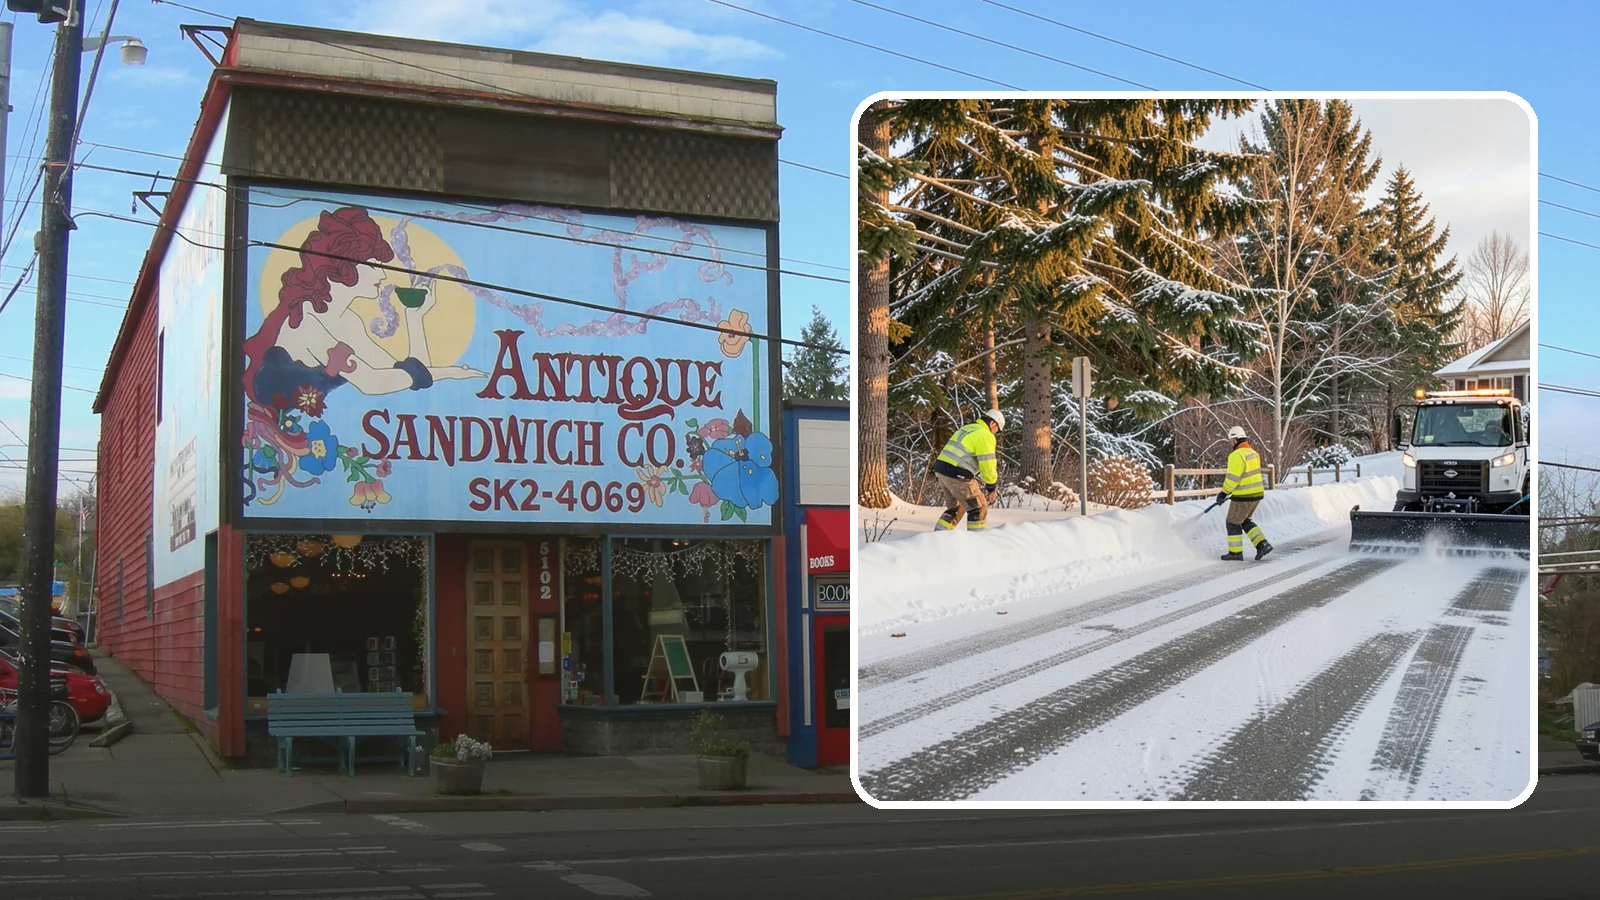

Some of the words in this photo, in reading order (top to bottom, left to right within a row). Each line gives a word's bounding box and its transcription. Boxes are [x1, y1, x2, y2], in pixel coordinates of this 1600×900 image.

[476, 328, 723, 421] ANTIQUE
[361, 408, 604, 467] SANDWICH
[617, 421, 684, 469] CO.
[468, 477, 646, 513] SK2-4069
[540, 541, 551, 599] 5102
[809, 555, 834, 568] BOOKS
